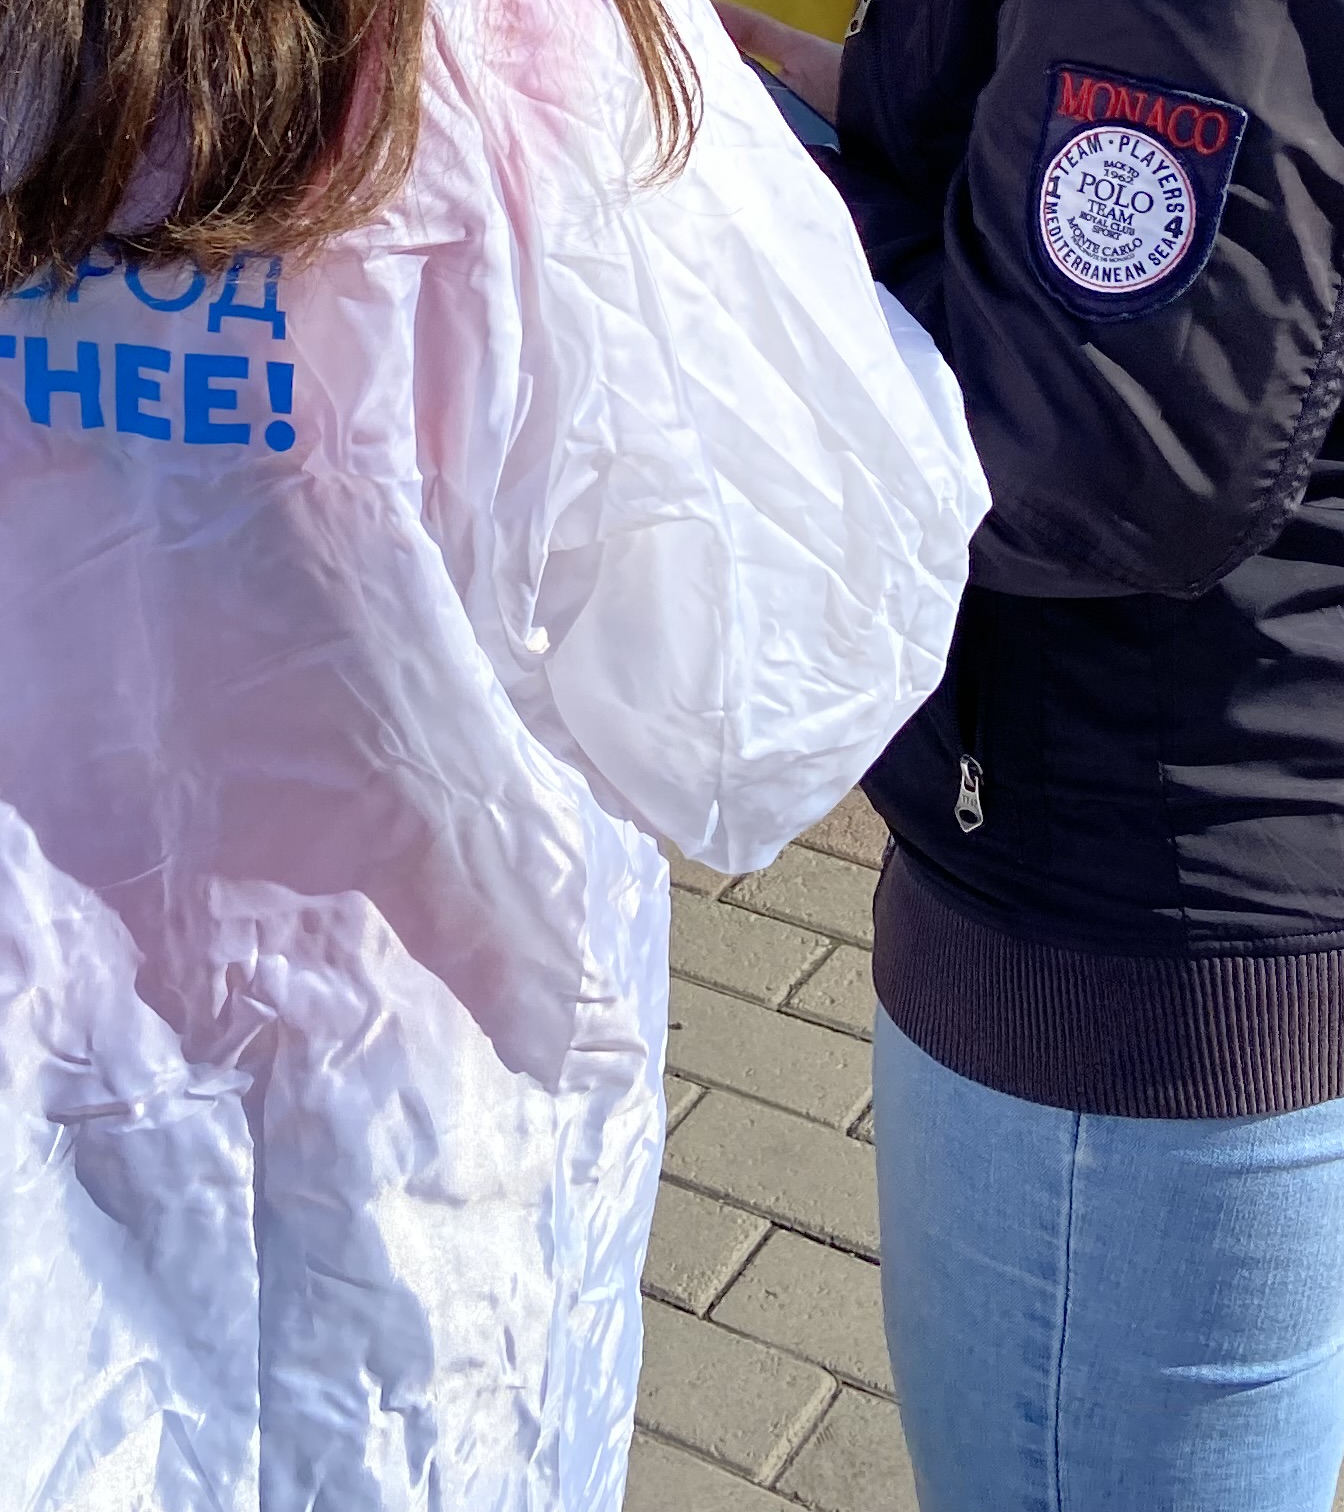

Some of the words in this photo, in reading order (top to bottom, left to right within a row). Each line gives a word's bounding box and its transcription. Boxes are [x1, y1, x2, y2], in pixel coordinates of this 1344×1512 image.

[1058, 72, 1229, 155] MONACO
[1055, 133, 1103, 176] TEAM
[1119, 134, 1185, 213] PLAYERS
[1076, 171, 1154, 214] POLO
[1087, 198, 1135, 226] TEAM
[1110, 222, 1136, 236] CLUB
[1044, 202, 1147, 283] MEDITERRANEAN
[1148, 237, 1177, 266] SEA
[1067, 216, 1101, 254] MONTE
[1101, 237, 1143, 257] CARLO
